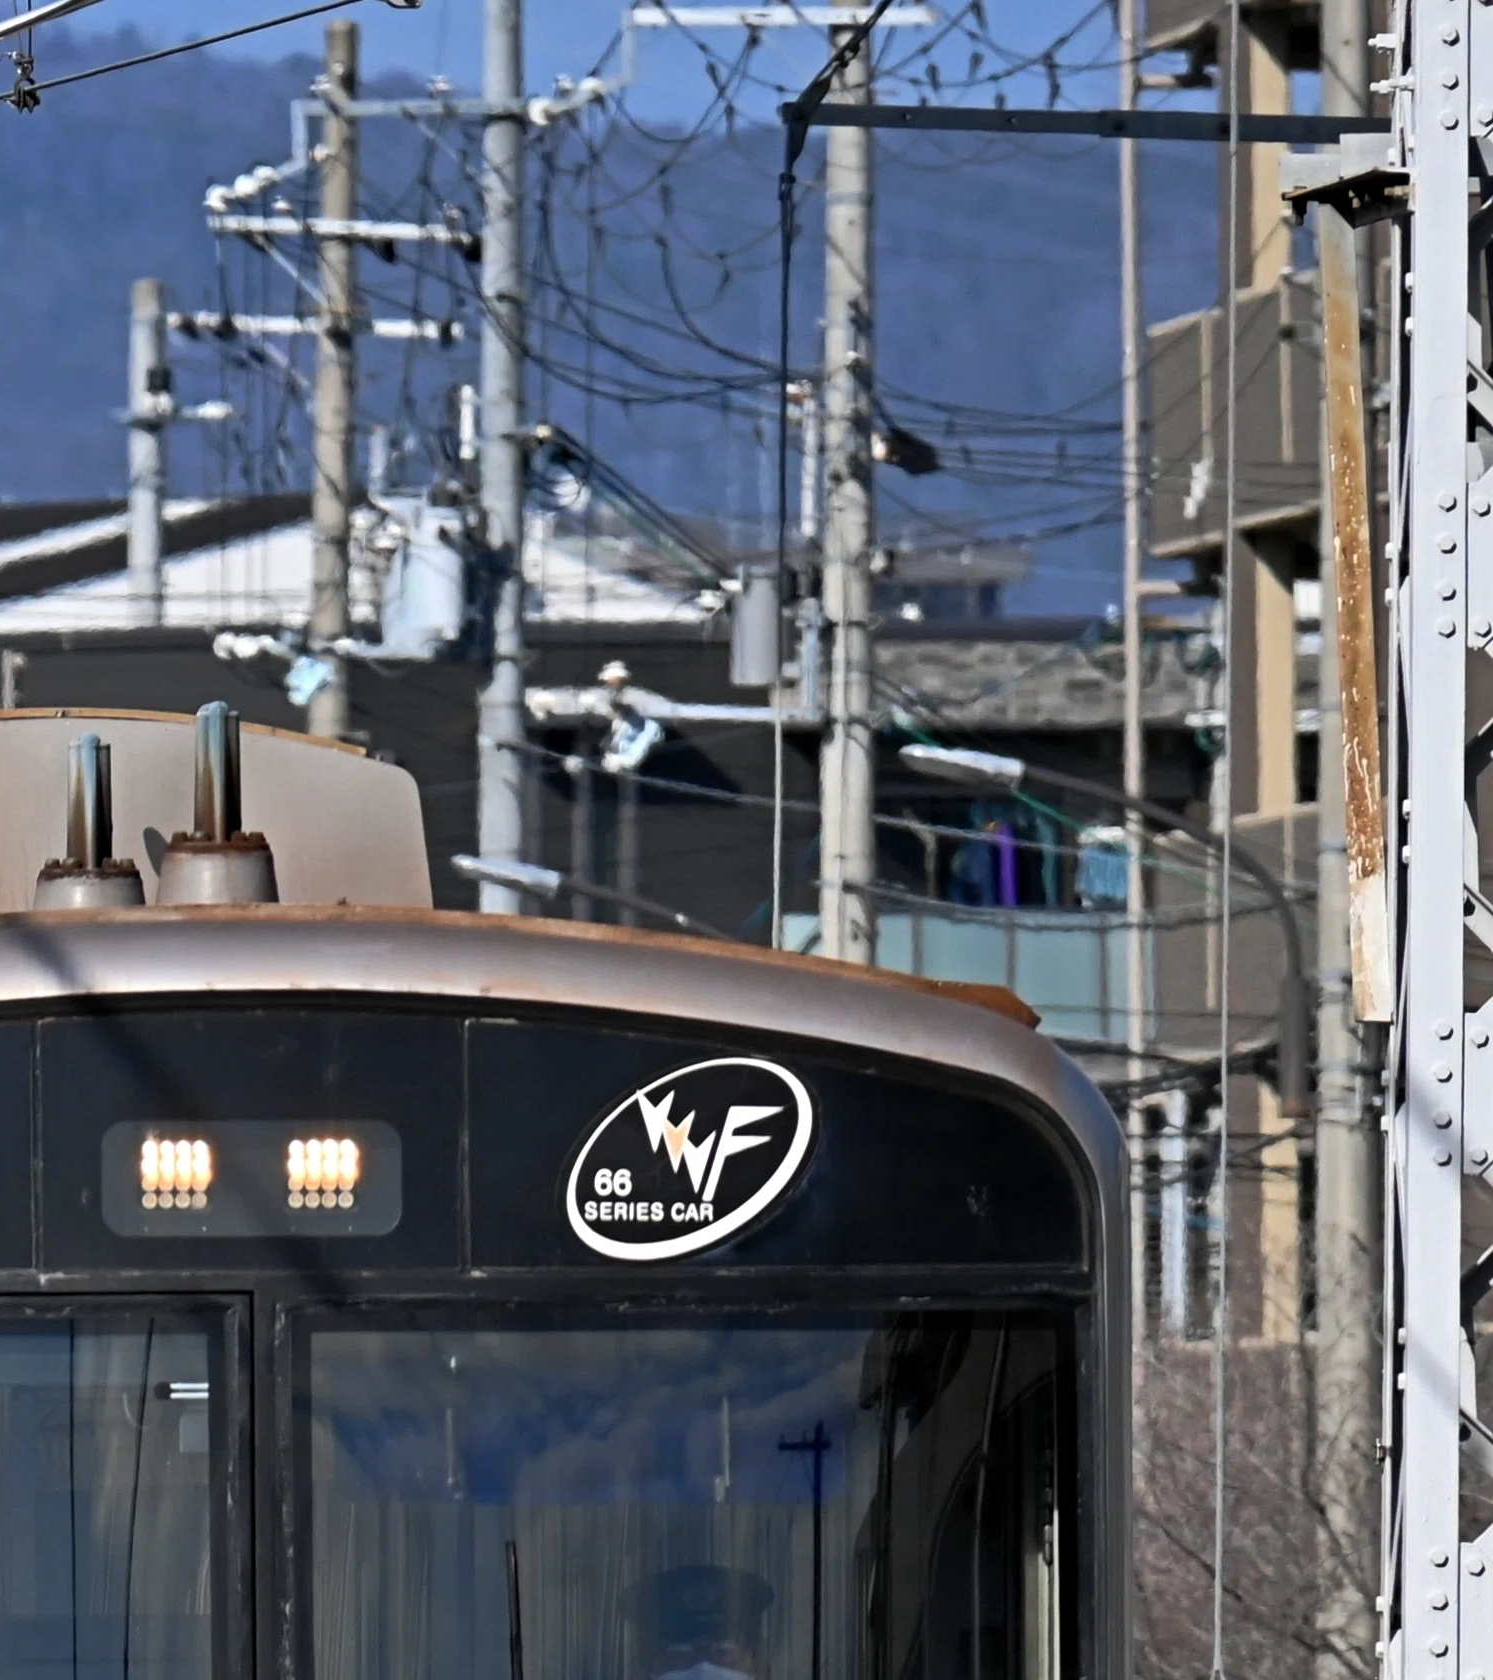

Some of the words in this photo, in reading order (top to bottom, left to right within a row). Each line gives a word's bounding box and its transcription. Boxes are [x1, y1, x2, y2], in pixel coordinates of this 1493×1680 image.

[593, 1167, 633, 1197] 66
[583, 1200, 665, 1222] SERIES
[670, 1201, 714, 1222] CAR
